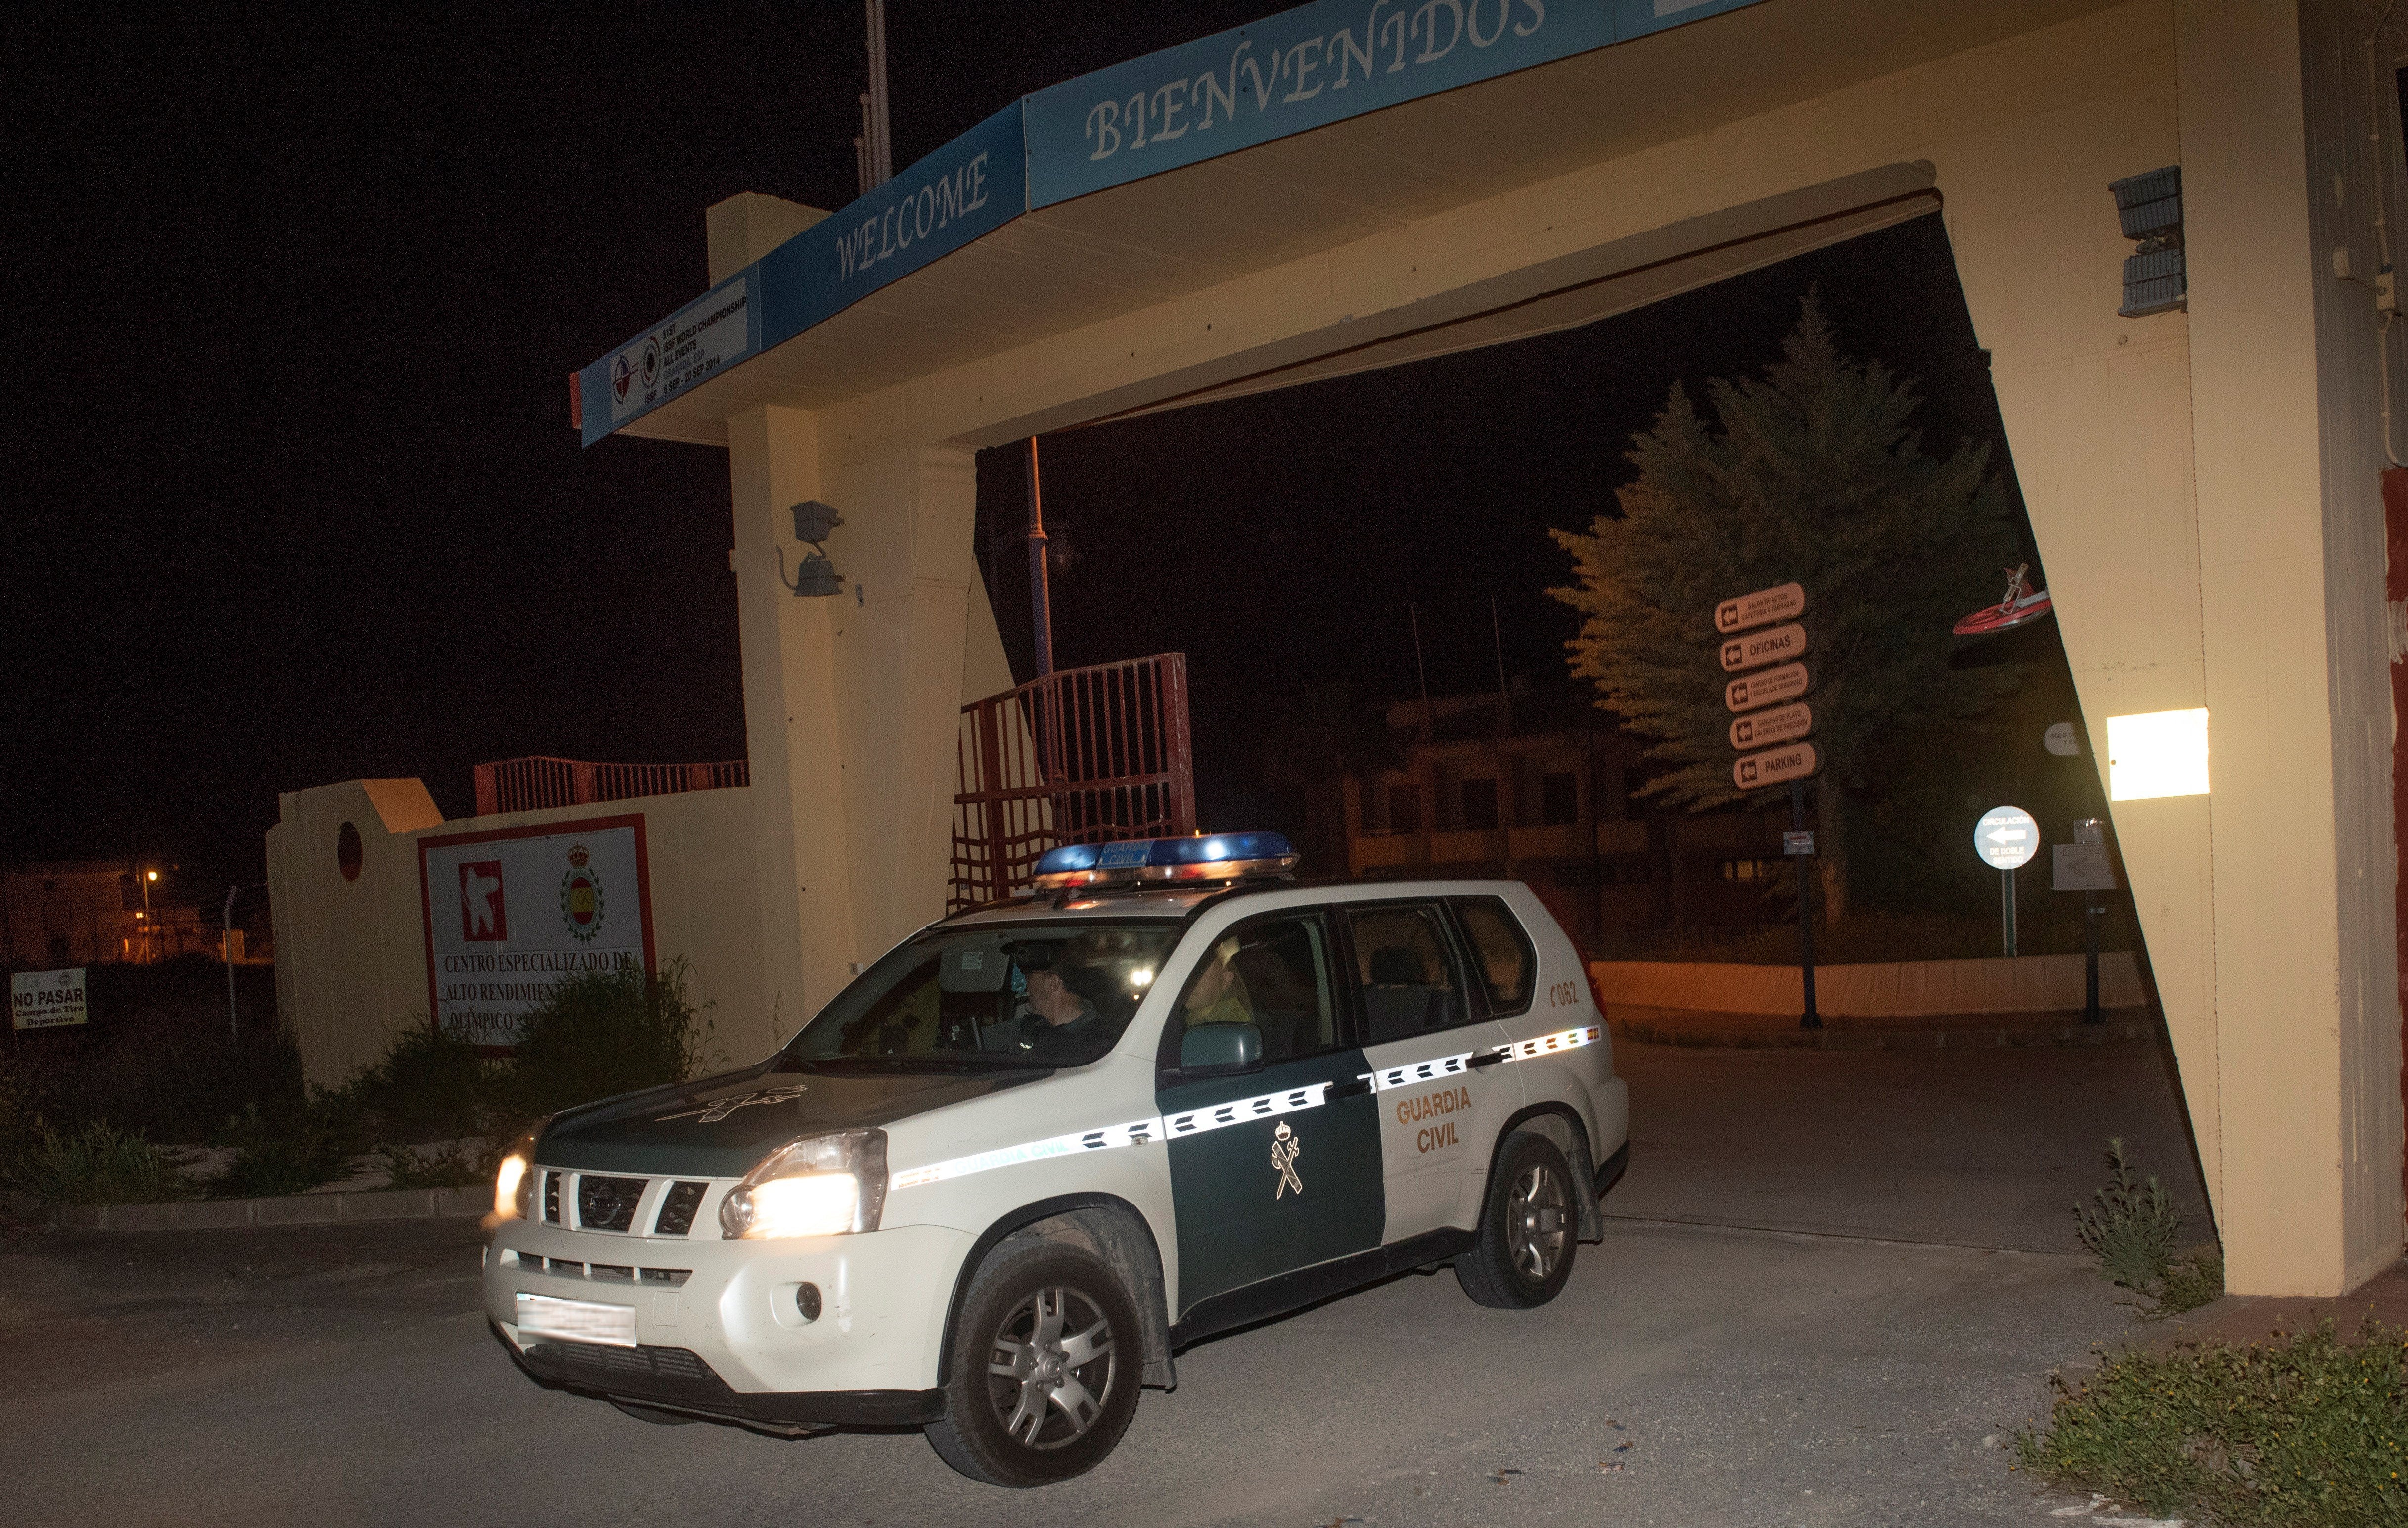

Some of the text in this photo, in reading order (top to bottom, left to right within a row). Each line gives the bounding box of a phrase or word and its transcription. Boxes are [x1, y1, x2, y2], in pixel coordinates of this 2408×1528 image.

[1085, 0, 1545, 161] BIENVENIDOS
[836, 151, 988, 282] WELCOME
[663, 296, 747, 353] ISSF WORLD CHAMPIONSHIP
[663, 323, 677, 340] 51ST
[663, 339, 697, 367] ALL EVENTS
[664, 385, 668, 395] 6
[669, 378, 680, 392] SEP
[684, 371, 692, 383] 20
[693, 364, 704, 378] SEP
[706, 355, 721, 371] 2014
[645, 389, 657, 404] ISSF
[1771, 599, 1797, 612] TERRAZAS
[1749, 635, 1791, 656] OFICINAS
[1757, 716, 1779, 727] CANCHAS
[1786, 710, 1801, 720] PLATO
[1765, 753, 1802, 772] PARKING
[1982, 814, 2030, 826] CIRCULACIÓN
[1103, 841, 1150, 854] GUARDIA
[2000, 846, 2024, 855] DOBLE
[1109, 854, 1134, 864] CIVIL
[1993, 856, 2024, 864] SENTIDO
[445, 951, 633, 972] CENTRO ESPECIALIZADO DE
[14, 988, 83, 1008] NO PASAR
[446, 983, 477, 1001] ALTO
[1556, 981, 1579, 1007] 062
[27, 1016, 75, 1026] Deportivo
[1397, 1086, 1472, 1125] GUARDIA
[1417, 1121, 1459, 1154] CIVIL
